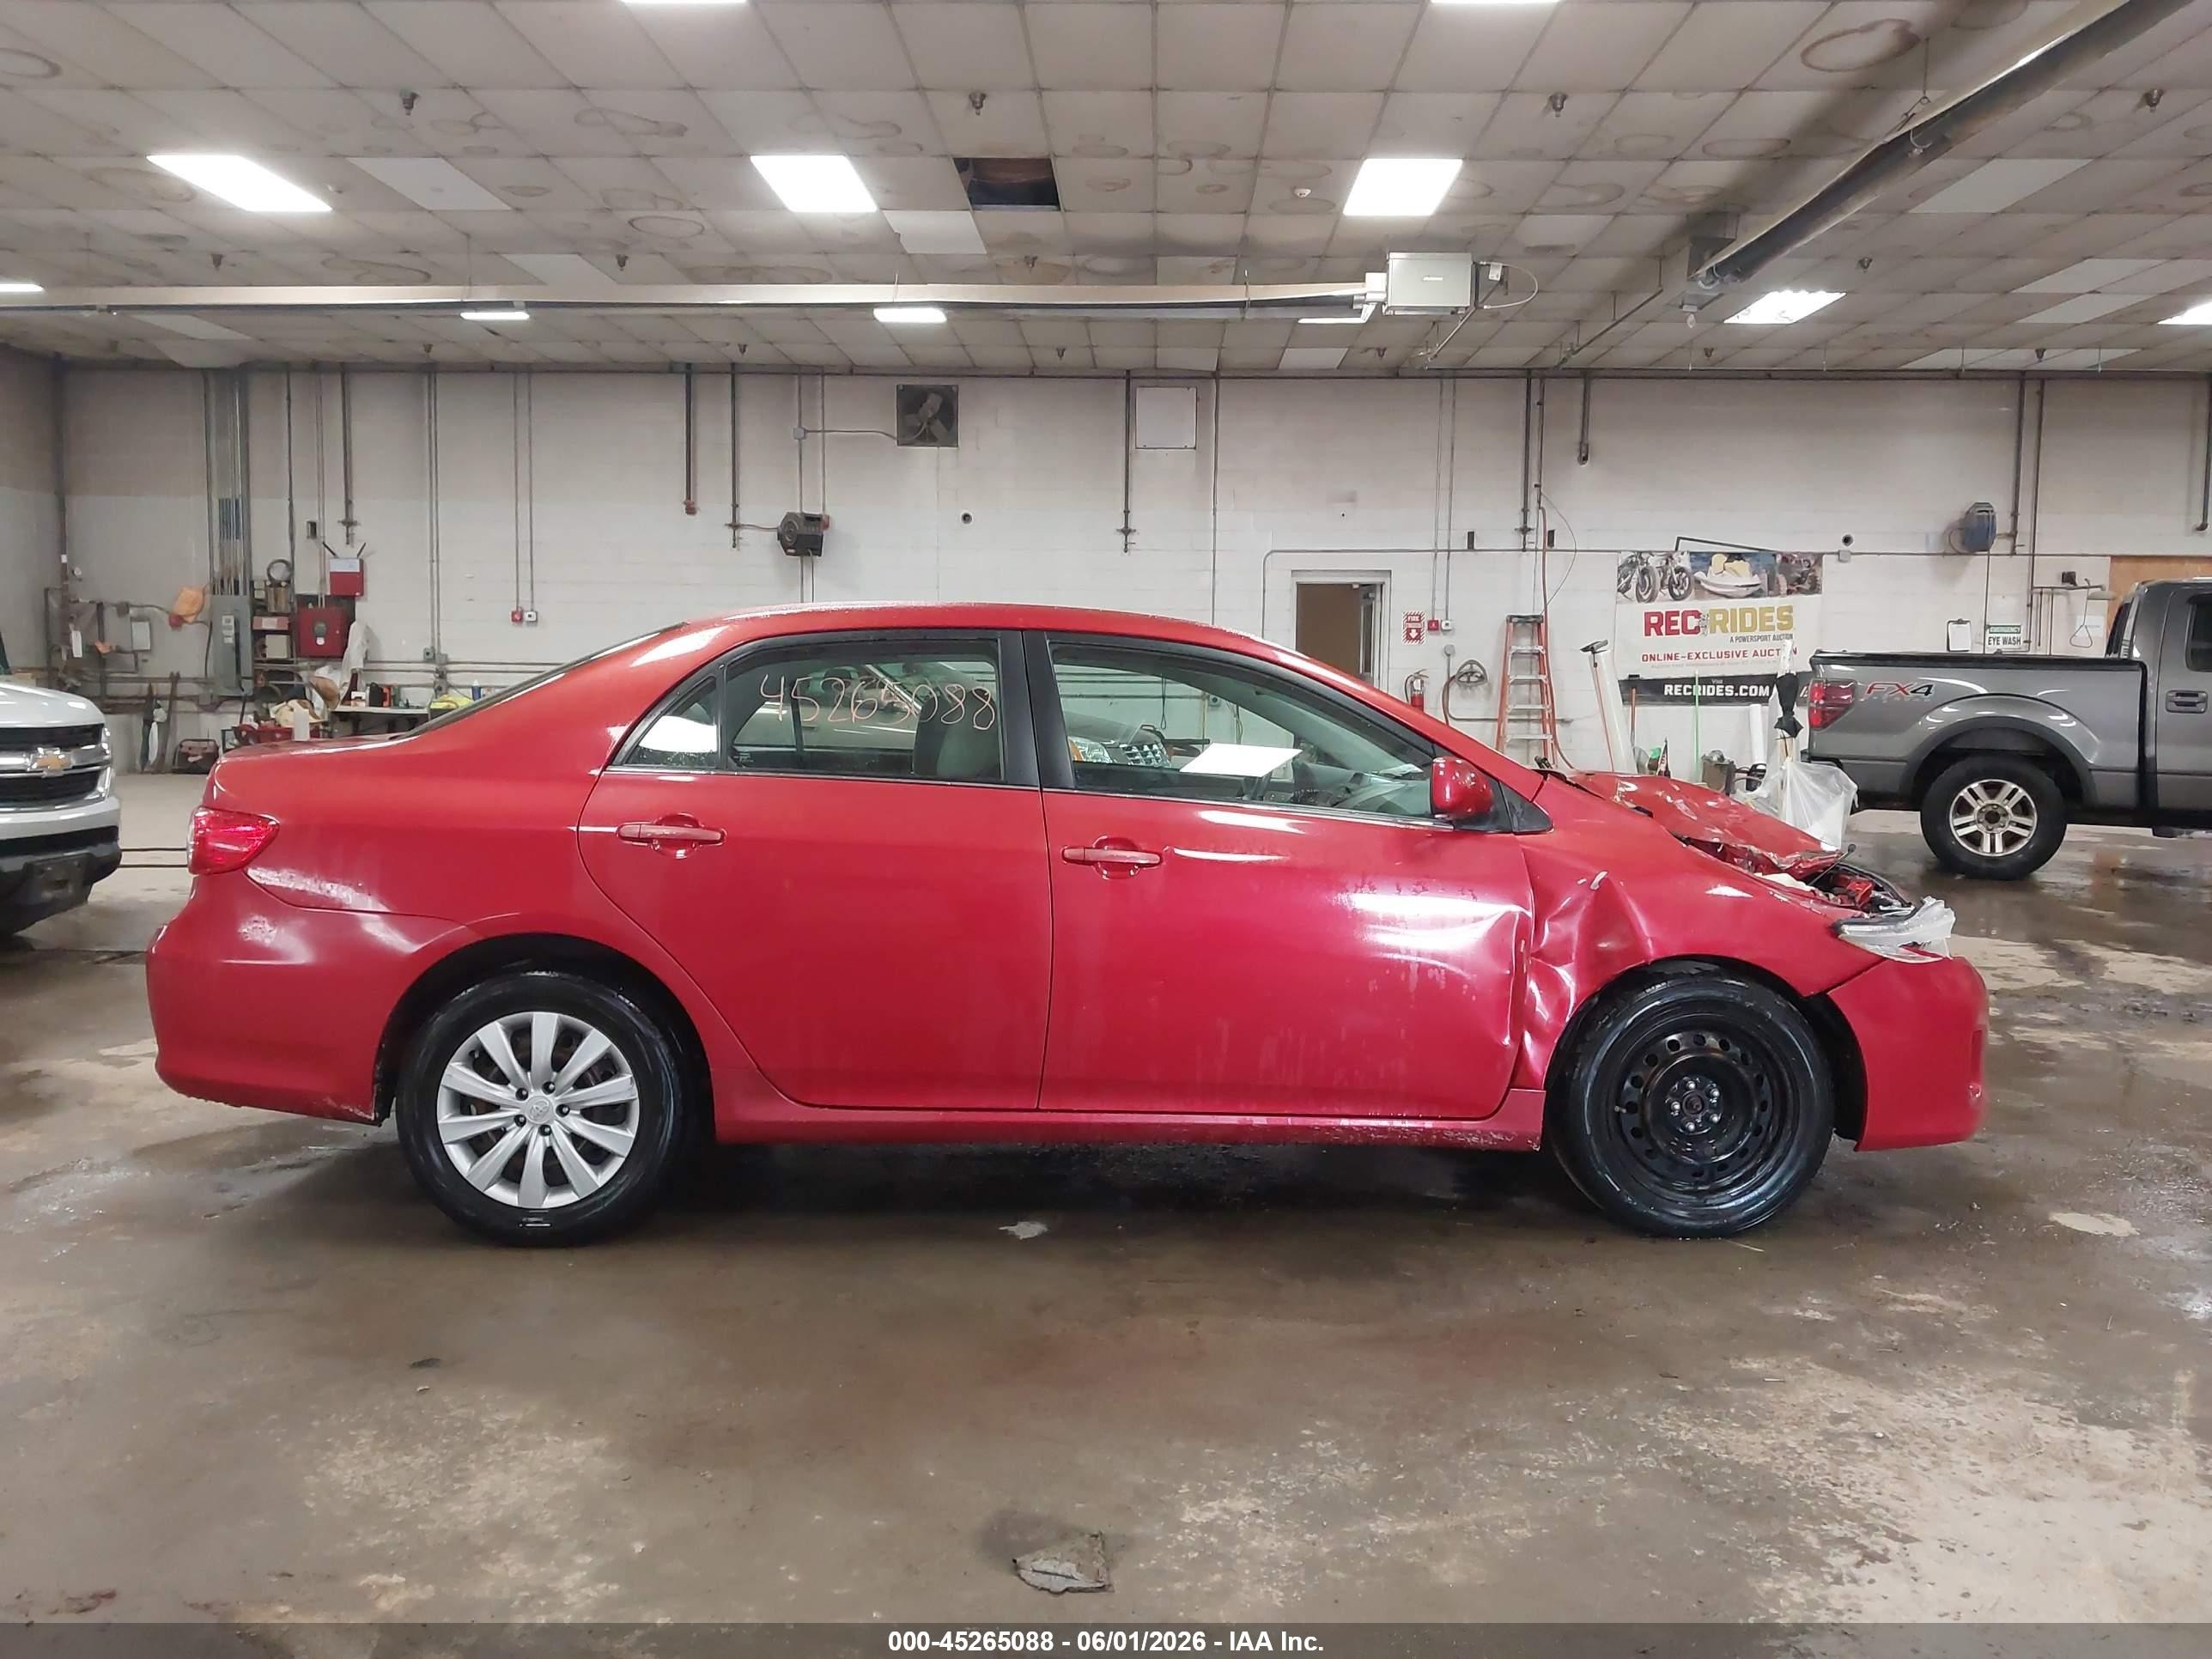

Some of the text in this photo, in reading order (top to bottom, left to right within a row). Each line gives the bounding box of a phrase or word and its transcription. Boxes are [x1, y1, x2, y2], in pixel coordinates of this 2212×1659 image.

[1644, 605, 1794, 636] REC RIDES
[1735, 635, 1771, 643] POWERSPORT
[1772, 633, 1794, 641] AUCTION
[1988, 636, 2021, 646] EYE WASH
[1752, 647, 1798, 658] AUCTN
[1663, 684, 1770, 696] RECRIDES.COM
[1866, 682, 1935, 696] FX4
[760, 673, 996, 730] 45265088
